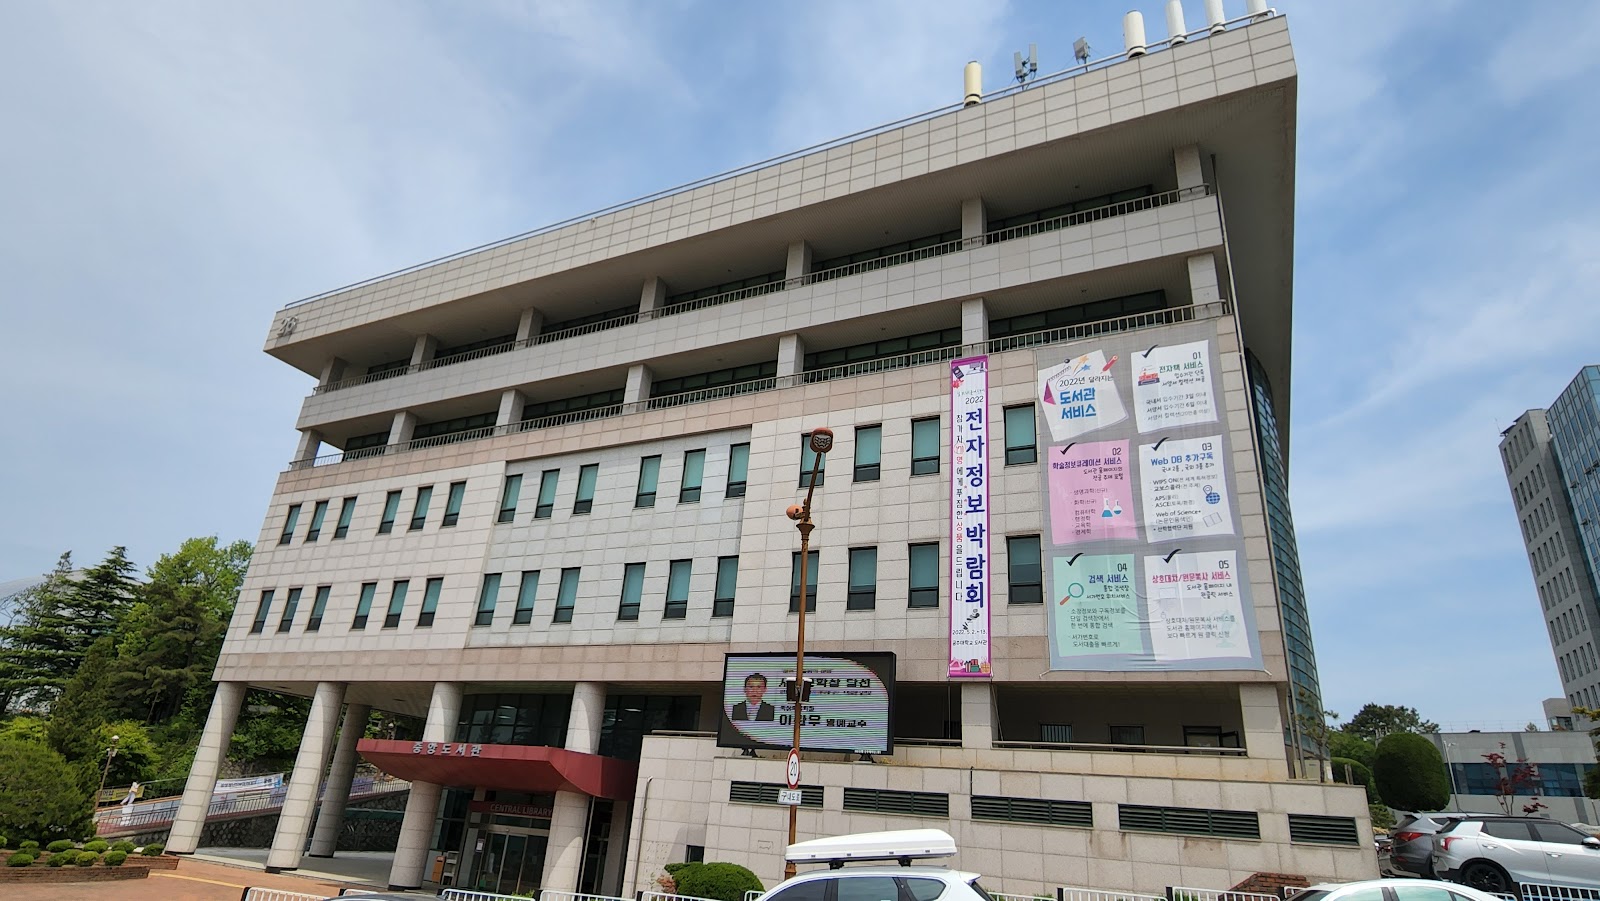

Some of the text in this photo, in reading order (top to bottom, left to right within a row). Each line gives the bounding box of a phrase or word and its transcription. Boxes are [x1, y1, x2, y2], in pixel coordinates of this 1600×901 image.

[1192, 352, 1202, 360] 01
[1159, 361, 1204, 374] 전자책 서비스
[1059, 375, 1114, 388] 2022년 달라지는
[966, 396, 984, 404] 2022
[1060, 387, 1096, 405] 도서관
[1062, 404, 1096, 420] 서비스
[1164, 402, 1184, 410] 입수기간
[1112, 448, 1122, 456] 02
[1202, 442, 1212, 451] 03
[1052, 457, 1122, 470] 학술정보큐레이션 서비스
[1150, 452, 1214, 466] Web DB 추가구독
[966, 408, 986, 608] 전자정보박람회
[1117, 562, 1128, 572] 04
[1218, 560, 1230, 570] 05
[1088, 574, 1129, 584] 검색 서비스
[1152, 570, 1232, 584] 상호대차/원문복사 서비스
[846, 678, 870, 688] 당선
[412, 742, 482, 758] 중앙도서관
[790, 760, 798, 776] 20
[490, 803, 552, 816] CENTRAL LIBRARY
